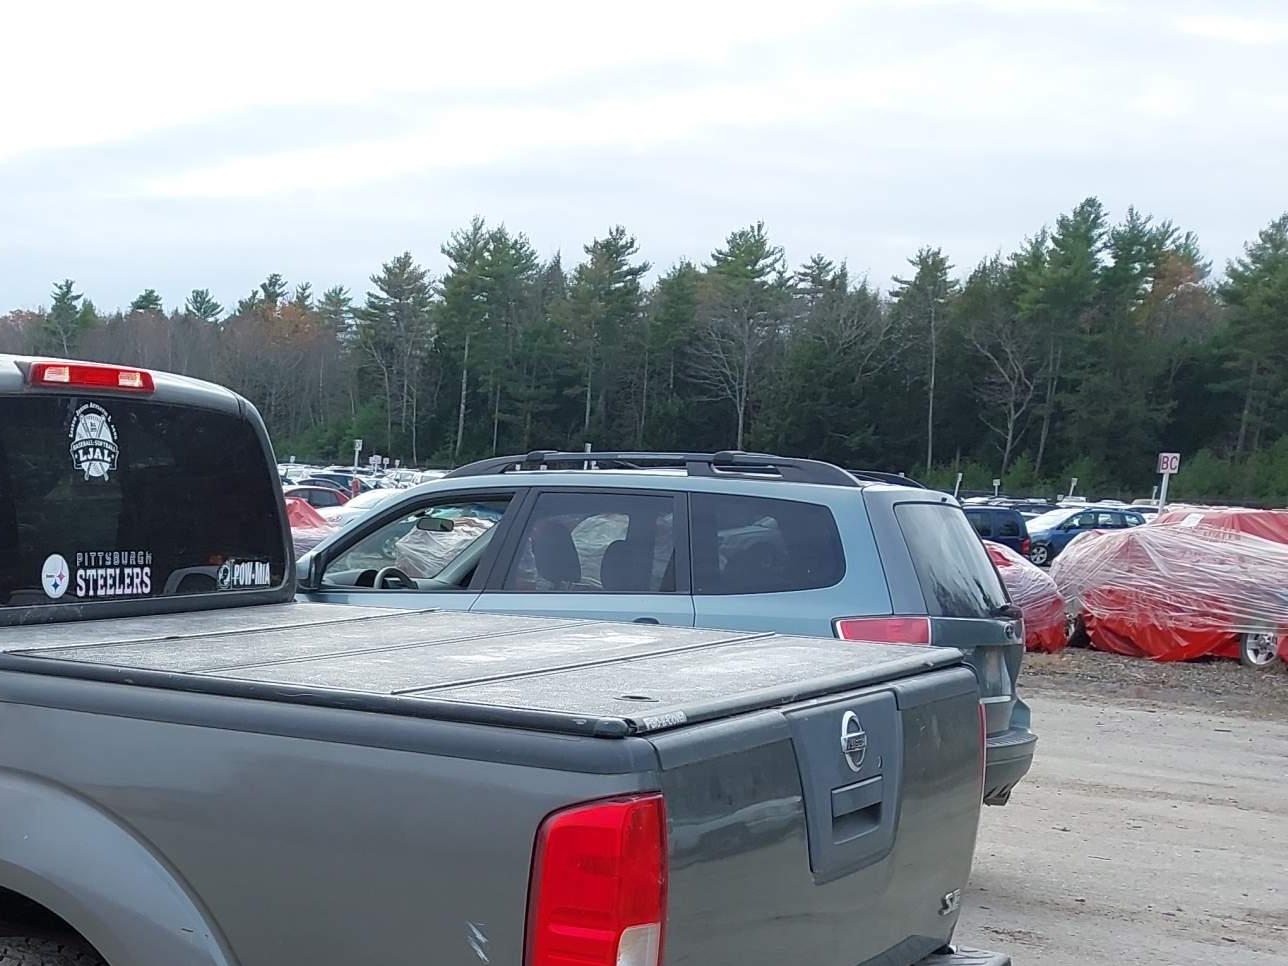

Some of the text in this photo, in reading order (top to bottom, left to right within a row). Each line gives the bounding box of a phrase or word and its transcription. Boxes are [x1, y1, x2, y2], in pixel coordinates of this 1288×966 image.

[78, 447, 111, 462] LJAL
[1161, 456, 1178, 470] BC
[76, 551, 152, 567] PITTSBURGH
[76, 566, 151, 597] STEELERS
